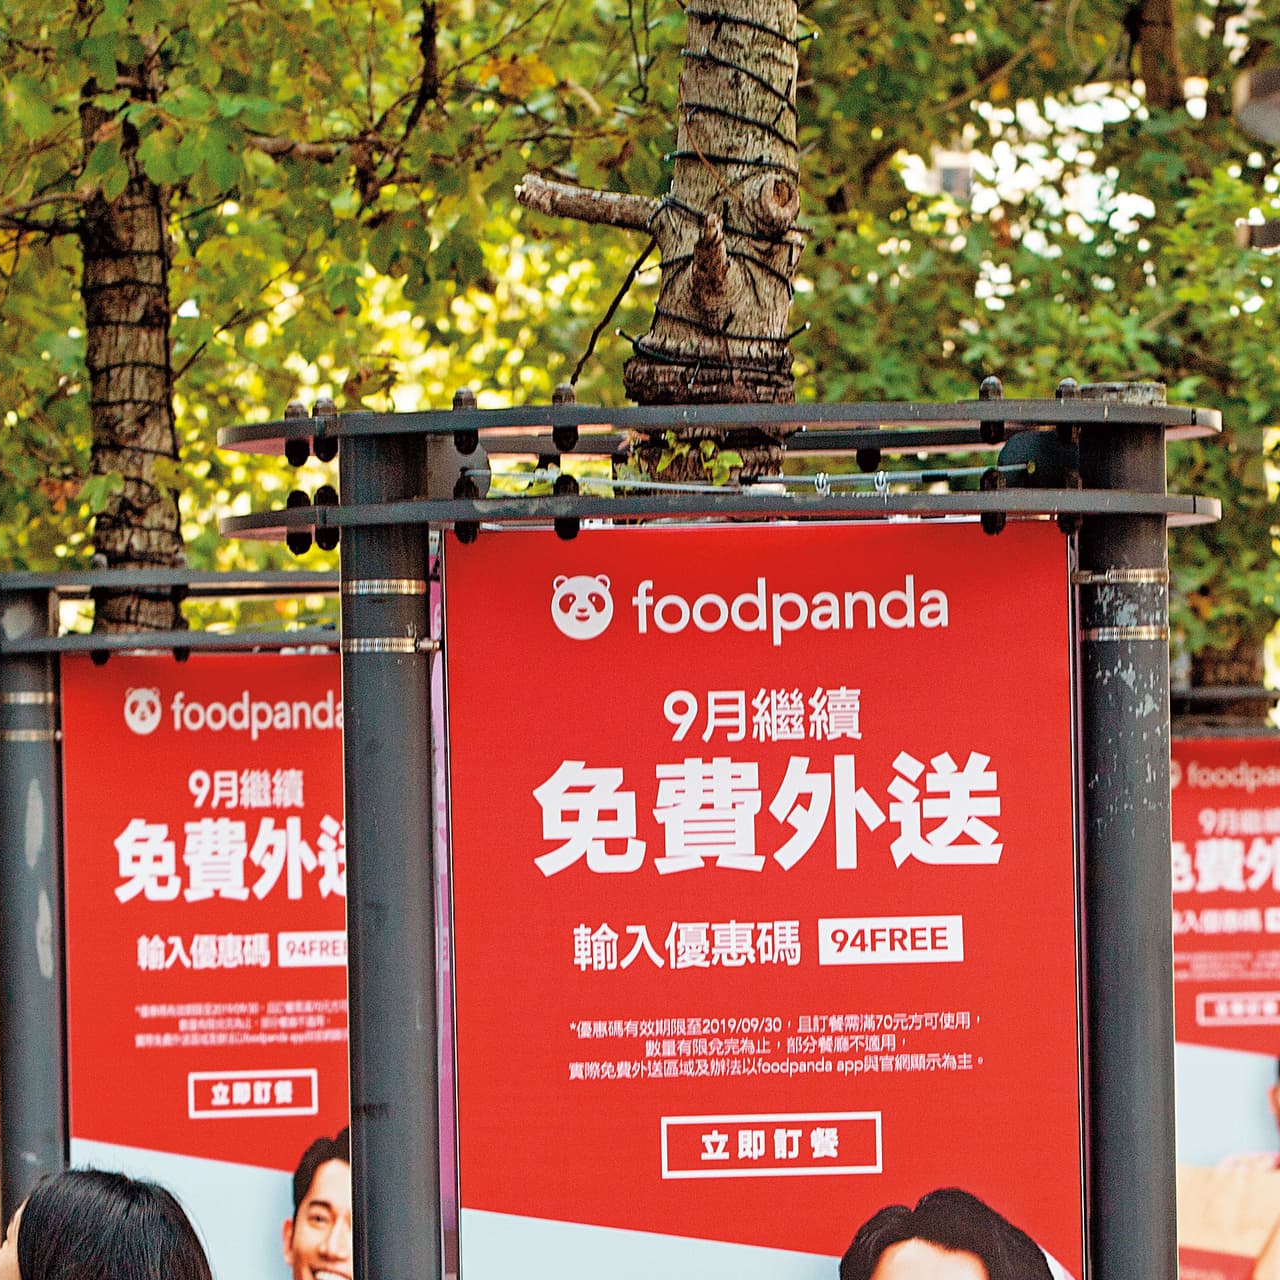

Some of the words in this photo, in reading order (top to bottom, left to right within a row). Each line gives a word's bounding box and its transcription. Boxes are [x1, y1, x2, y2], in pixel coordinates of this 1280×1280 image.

[632, 575, 950, 646] foodpanda
[664, 687, 863, 743] 9月繼續
[189, 769, 306, 809] 9月繼續
[533, 751, 1005, 878] 免費外送
[573, 920, 802, 972] 輸入優惠碼
[829, 926, 950, 955] 94FREE
[701, 1129, 839, 1161] 立即訂餐
